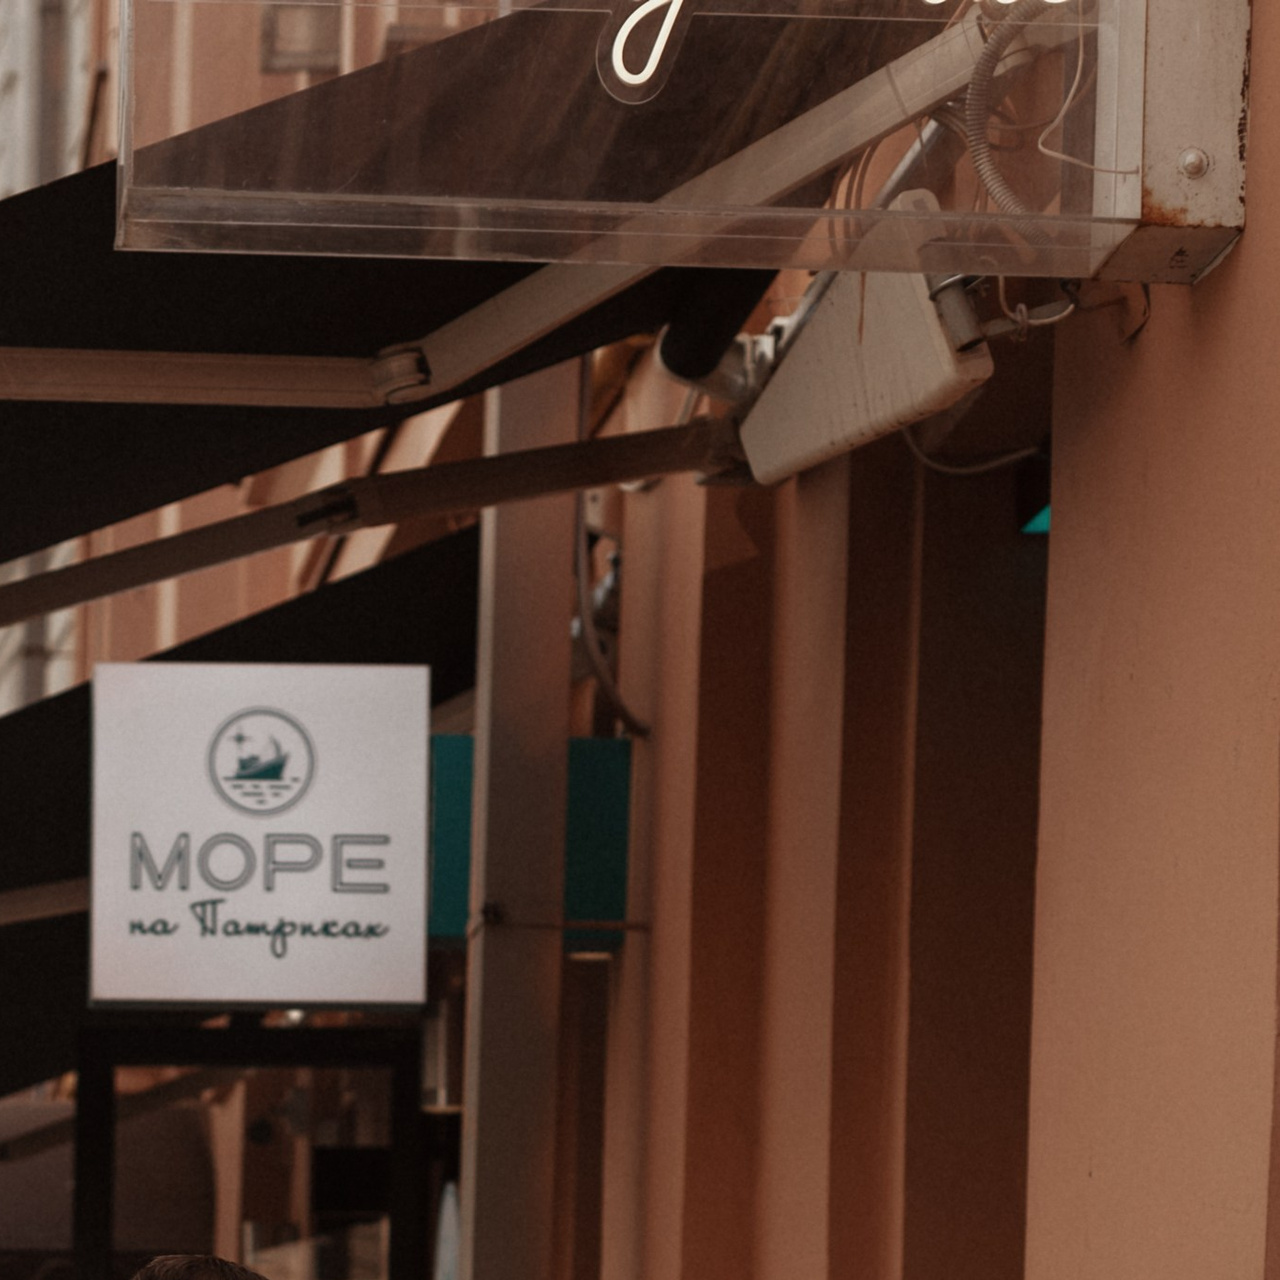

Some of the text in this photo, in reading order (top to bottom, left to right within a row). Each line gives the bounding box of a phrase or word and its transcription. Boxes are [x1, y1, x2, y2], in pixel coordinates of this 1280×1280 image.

[129, 832, 391, 894] МОРЕ
[129, 898, 390, 960] на Патриках
